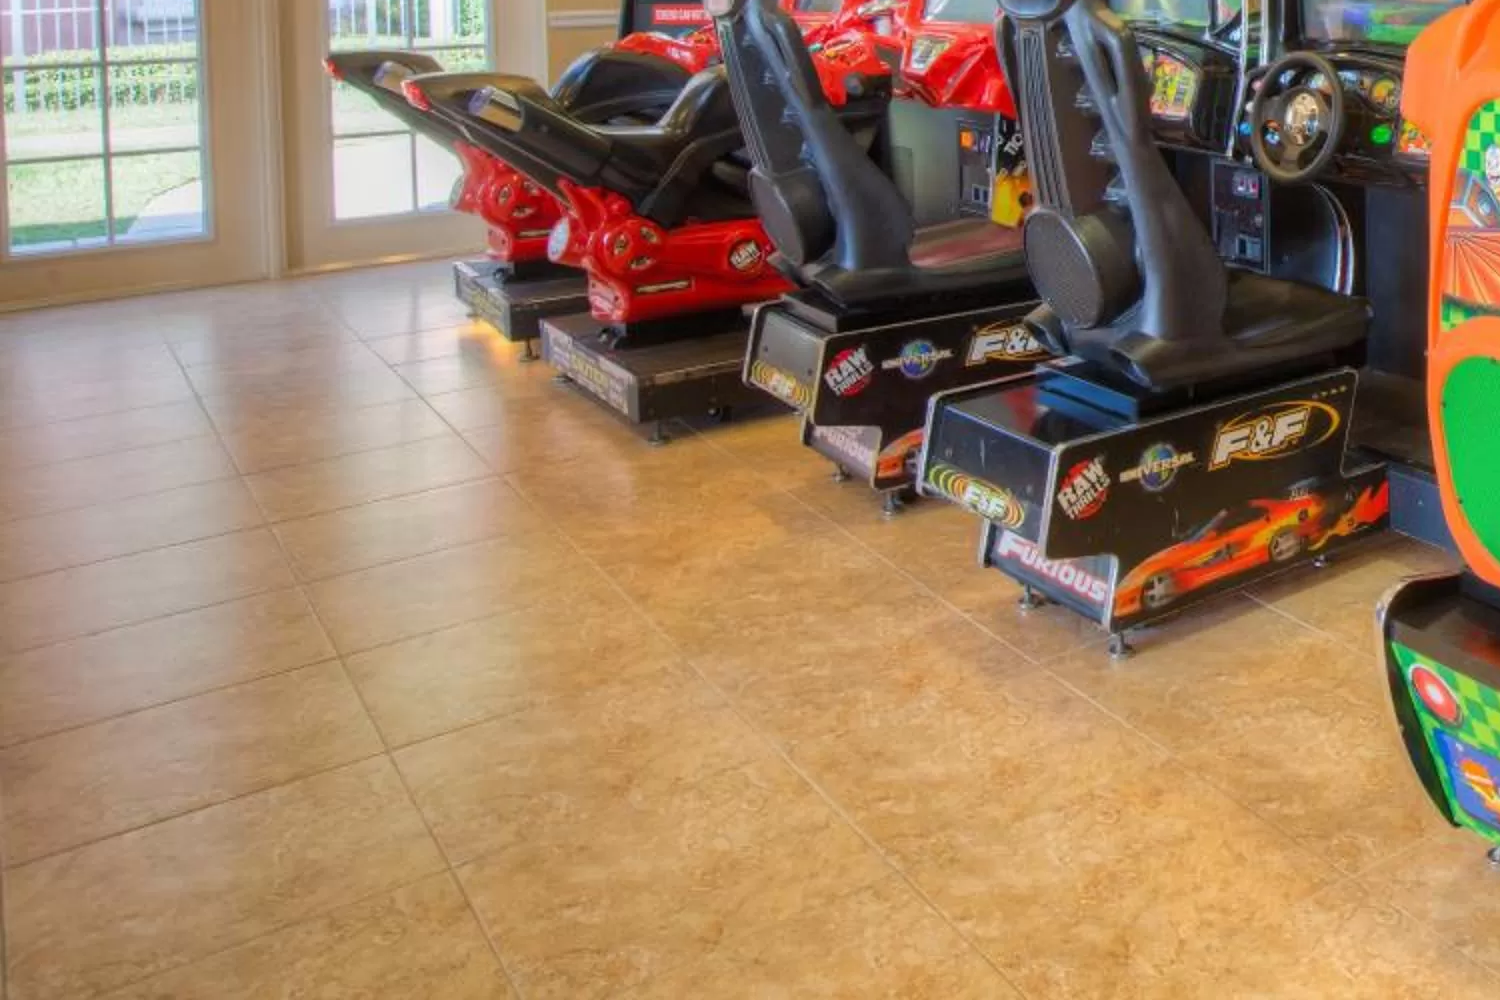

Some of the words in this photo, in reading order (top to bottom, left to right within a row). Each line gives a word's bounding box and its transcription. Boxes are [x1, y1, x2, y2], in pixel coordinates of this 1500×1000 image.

[1210, 407, 1310, 468] F&F
[1057, 456, 1104, 511] RAW
[998, 529, 1109, 602] FURIOUS
